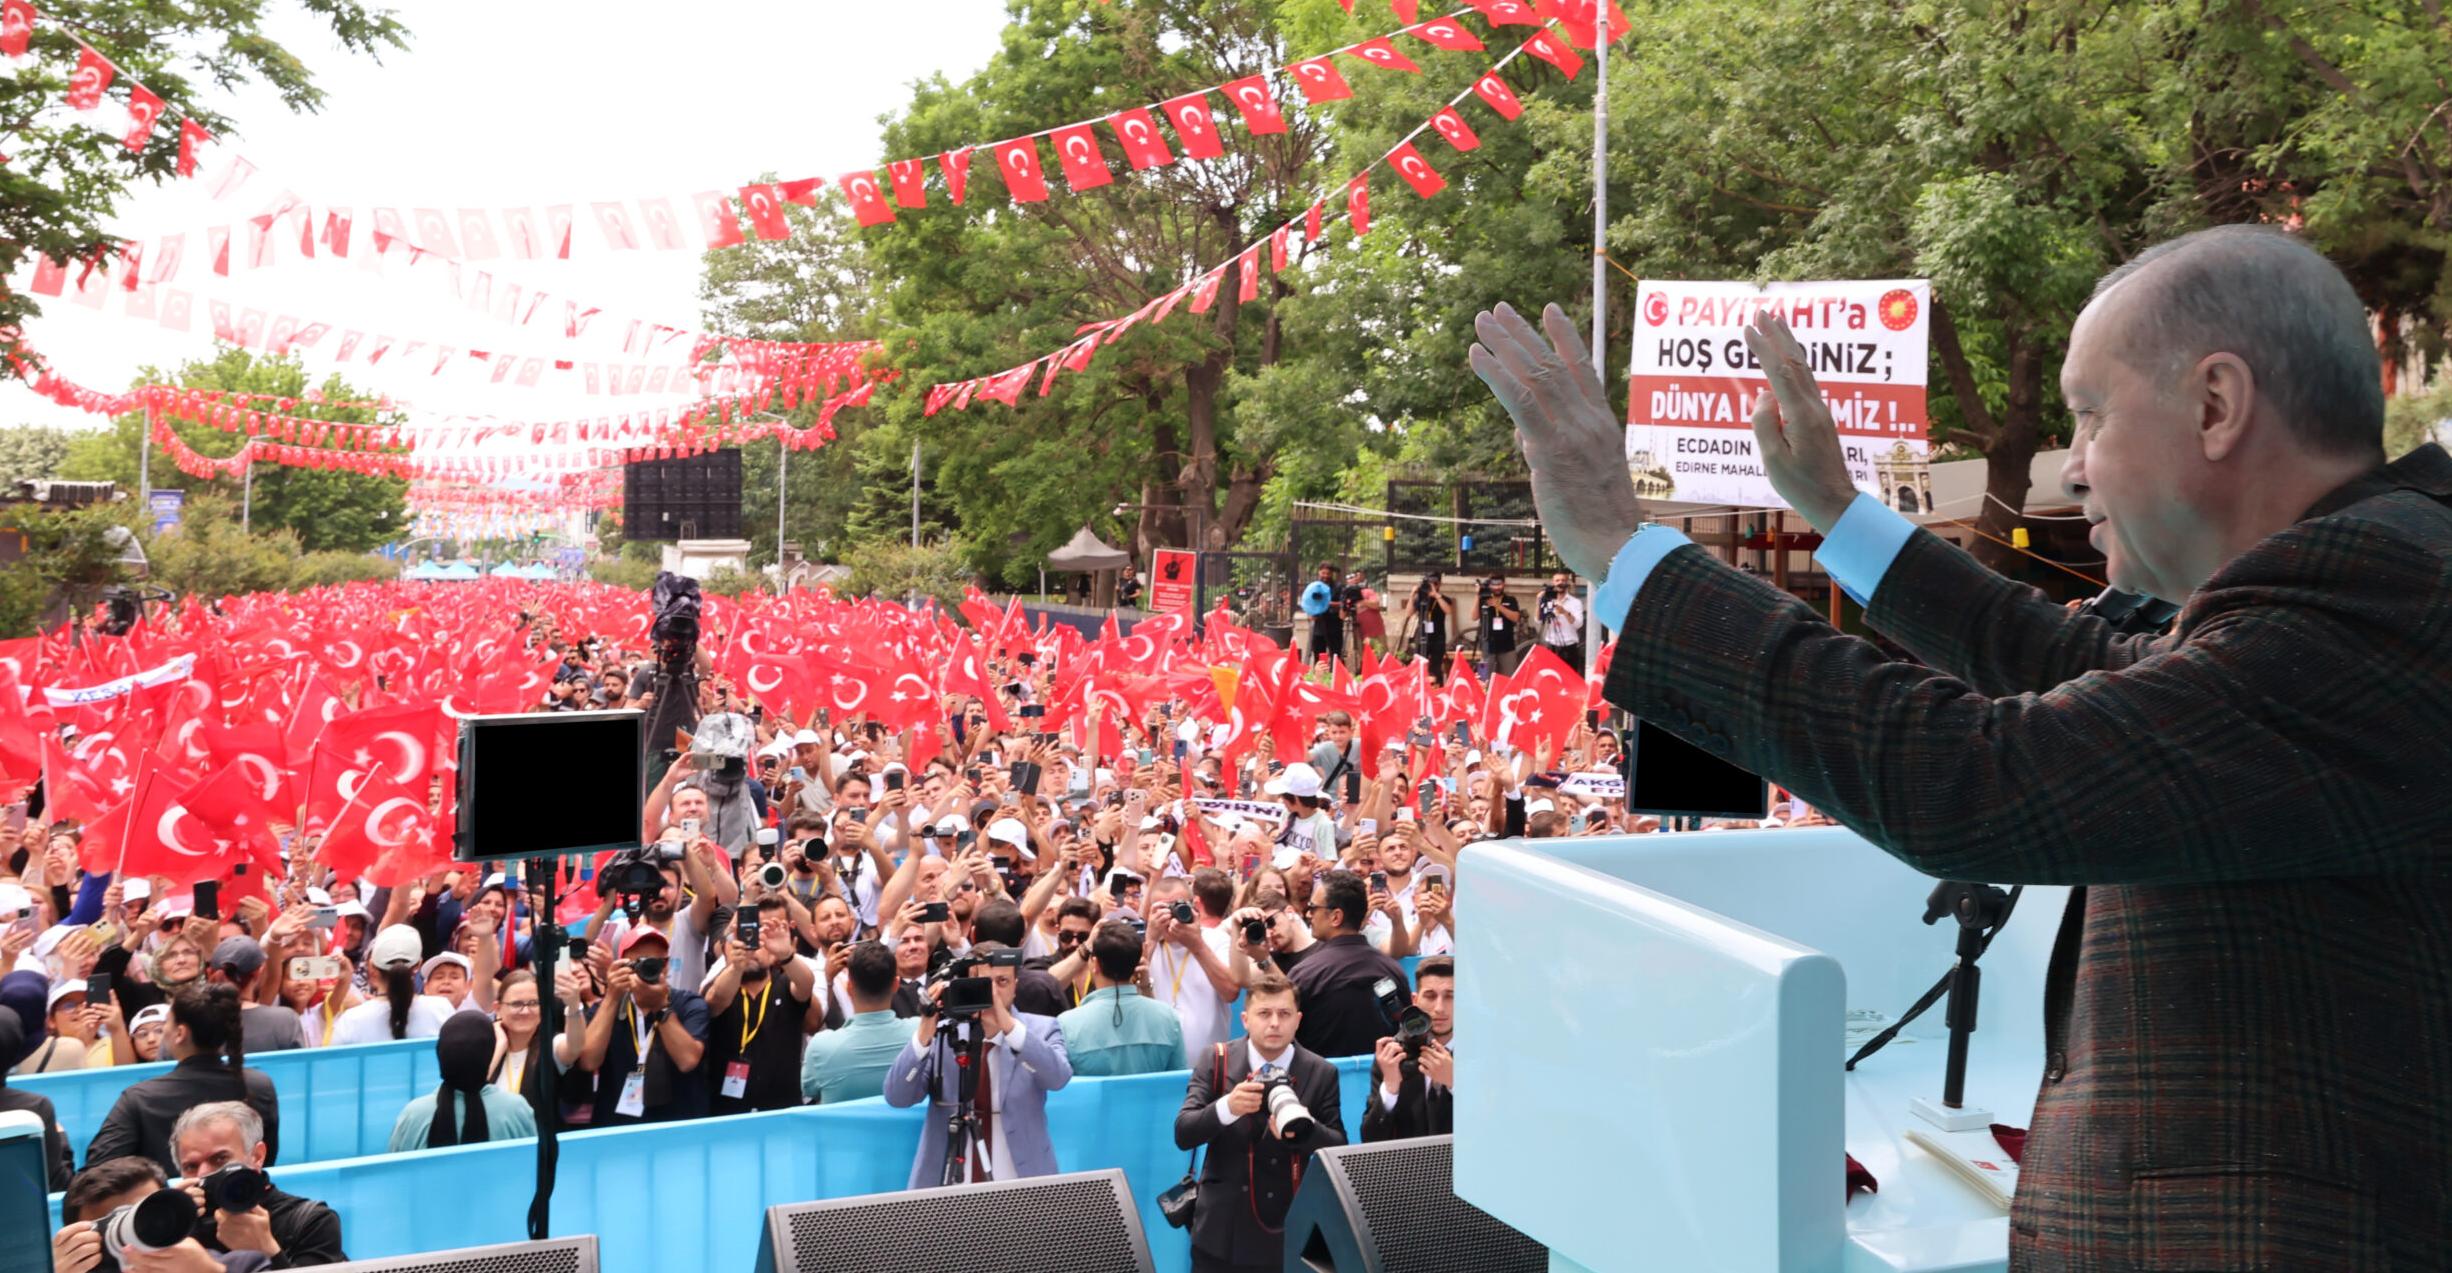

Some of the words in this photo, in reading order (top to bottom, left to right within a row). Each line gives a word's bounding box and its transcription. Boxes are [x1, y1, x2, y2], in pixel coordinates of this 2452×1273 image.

[1658, 338, 1713, 374] HOŞ
[1650, 383, 1735, 423] DÜNYA
[1676, 437, 1752, 457] ECDADIN
